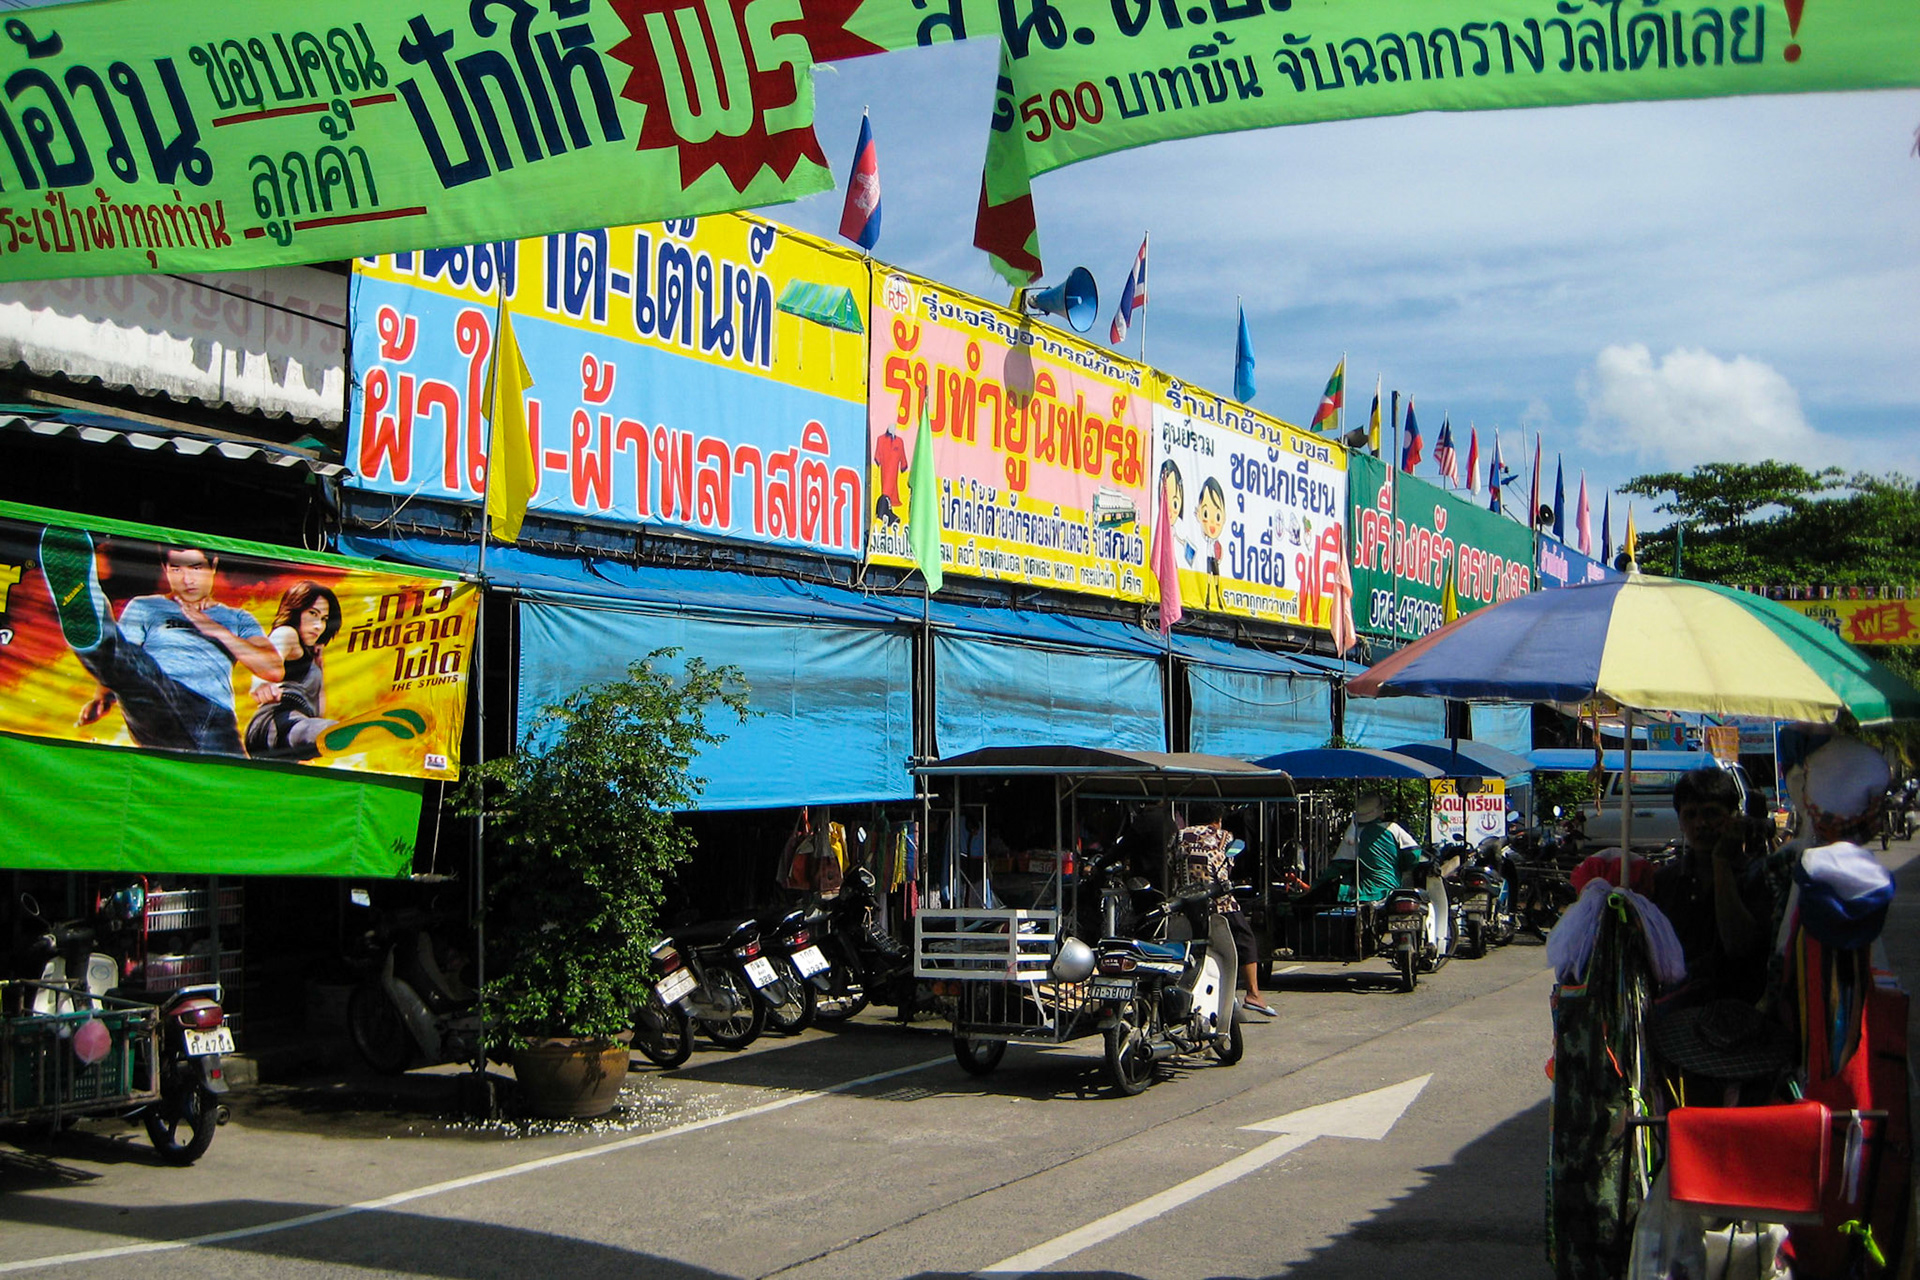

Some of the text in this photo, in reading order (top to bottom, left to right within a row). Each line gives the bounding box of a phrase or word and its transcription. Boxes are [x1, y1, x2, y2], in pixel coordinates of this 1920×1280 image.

[0, 18, 213, 192] อ้วน
[249, 113, 379, 246] ลูกค้า
[0, 189, 232, 268] ระเป๋าผ้าทุกท่าน
[359, 306, 861, 551] ผ้าใ-ผ้าพลาสติก
[886, 320, 1147, 490] รับทำยูนิฟอร์ม
[1162, 419, 1215, 457] ศูนย์รวม
[1166, 379, 1335, 465] ร้านโกอ้วน บขส.
[1230, 446, 1336, 518] ชุดนักเรียน
[1229, 516, 1286, 588] ปักชื่อ
[391, 675, 459, 692] THE STUNTS
